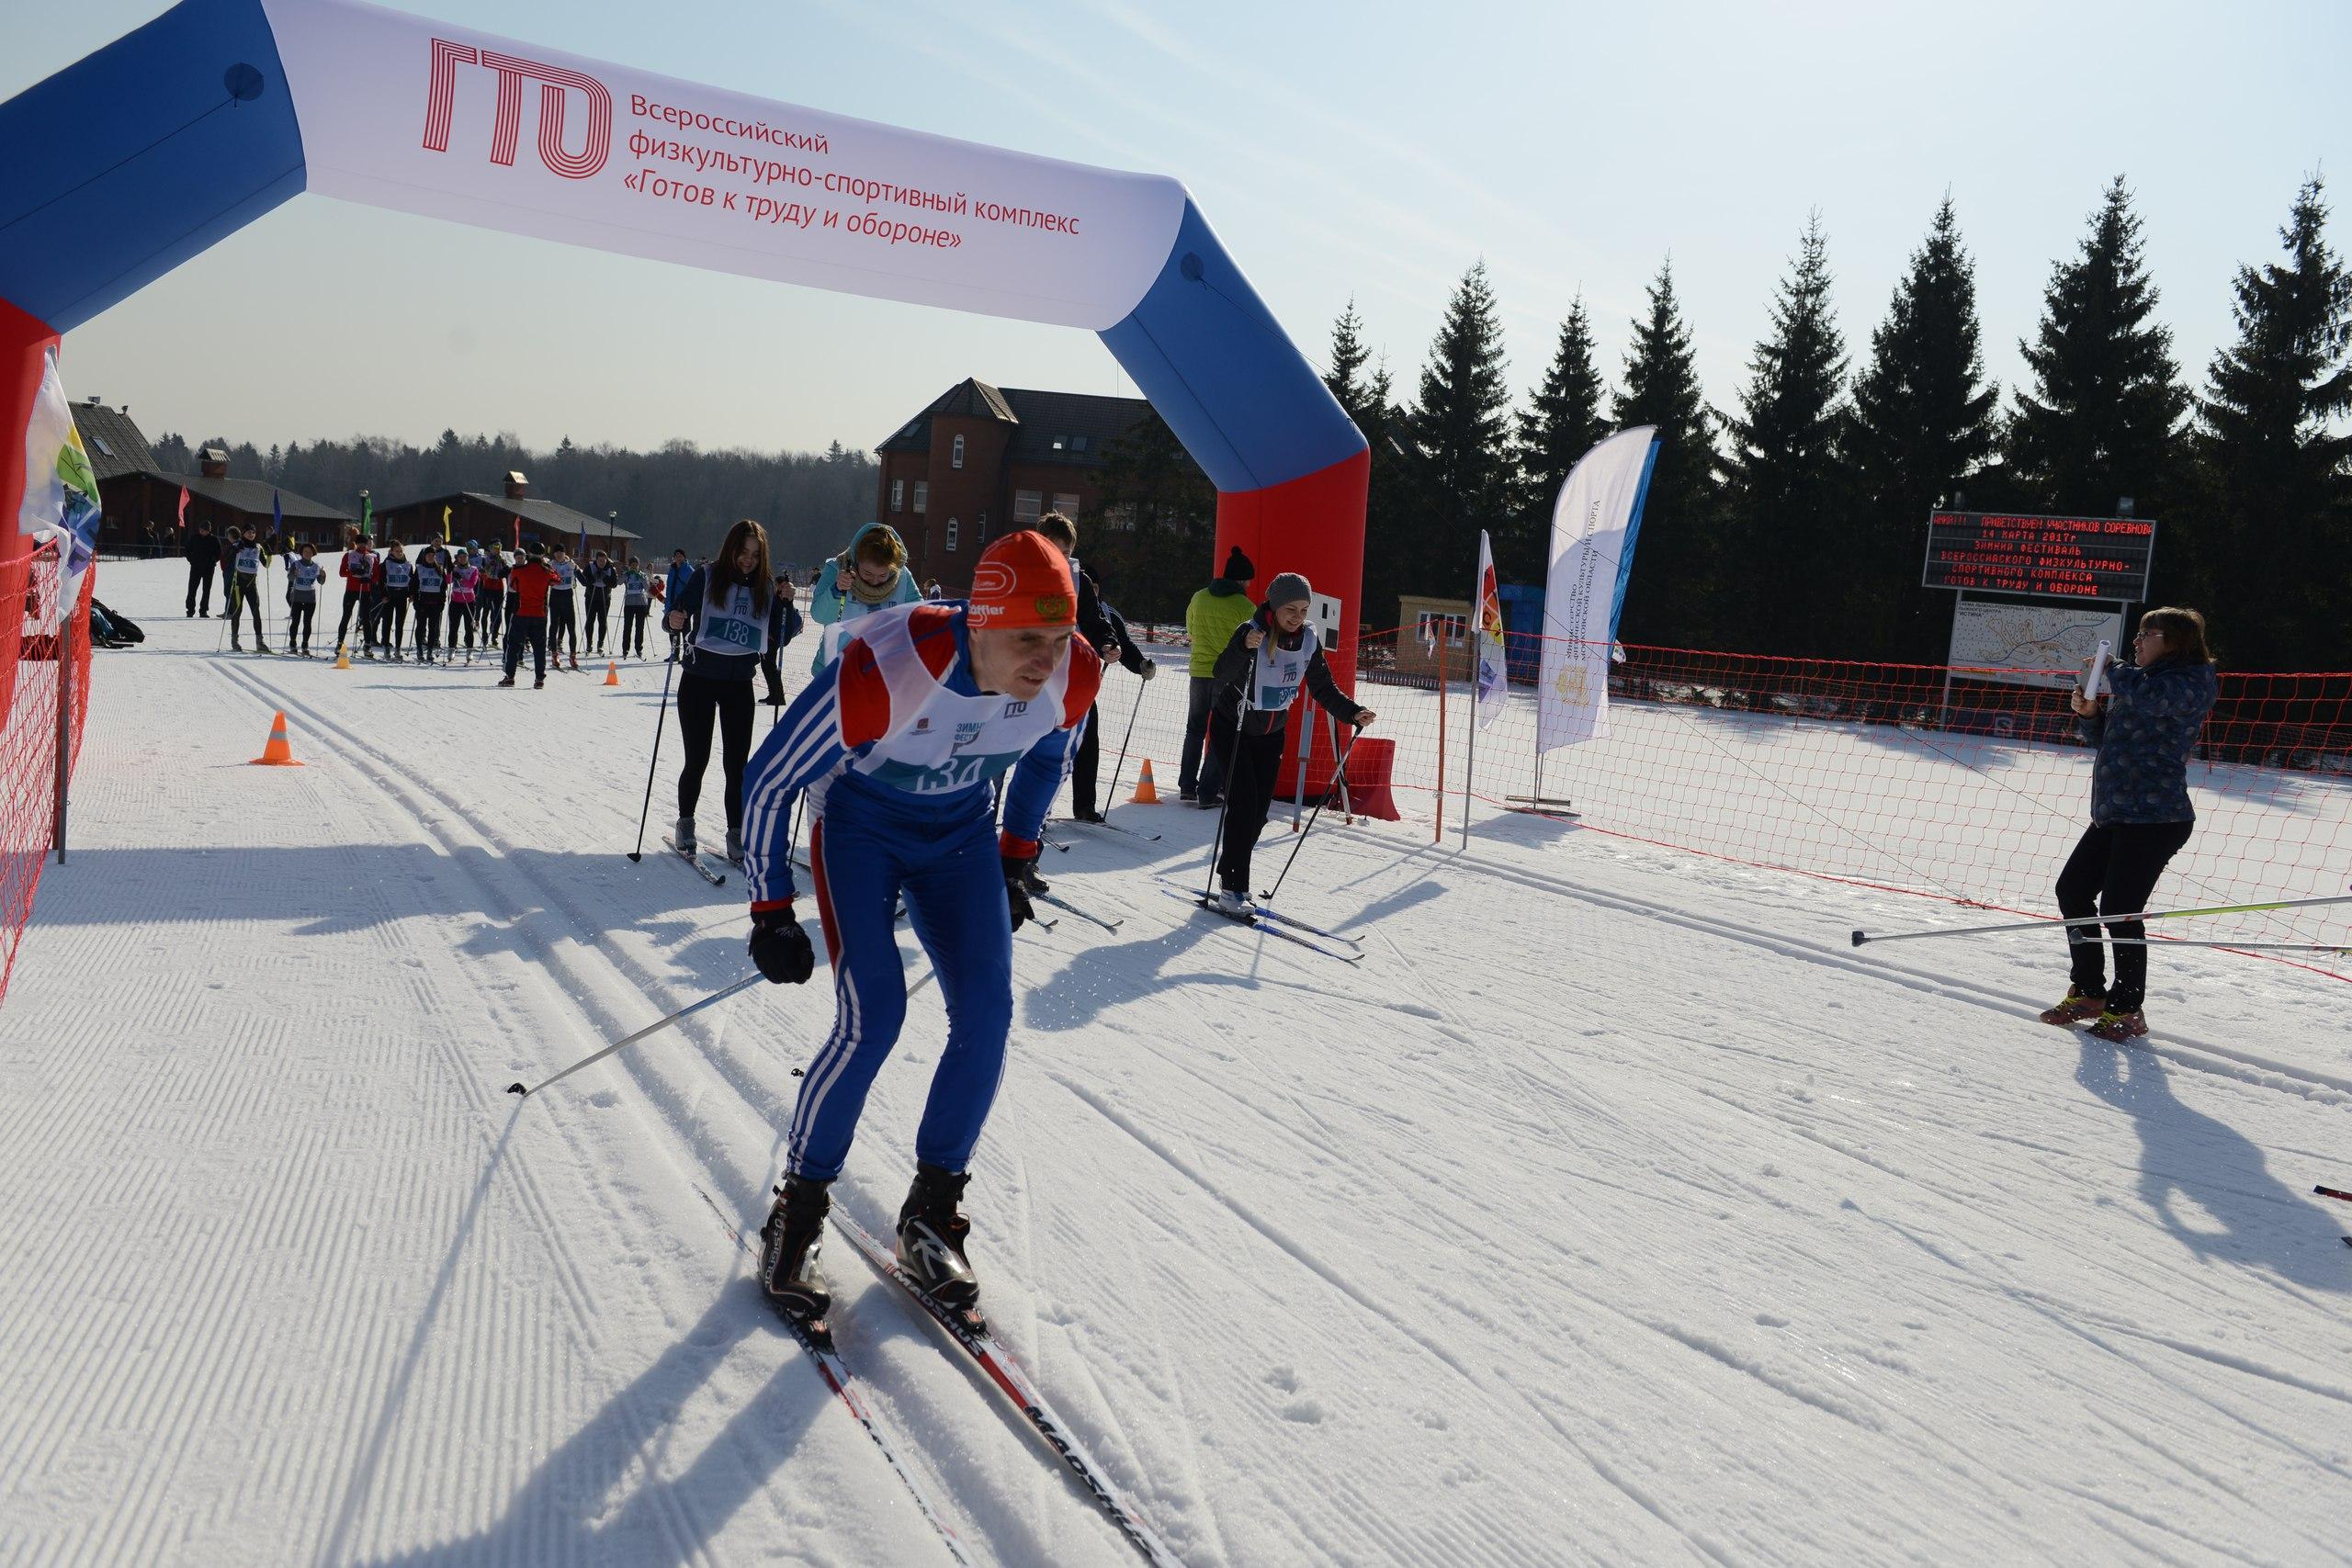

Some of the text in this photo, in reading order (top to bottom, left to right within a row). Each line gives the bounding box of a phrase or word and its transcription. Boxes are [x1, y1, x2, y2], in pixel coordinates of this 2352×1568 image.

[423, 38, 613, 180] ГТО
[630, 94, 829, 153] Всероссийский
[628, 130, 1080, 234] физкультурно-спортивный комплекс
[624, 168, 963, 249] «Готов к труду и обороне»
[1981, 529, 1996, 539] 14
[2001, 530, 2035, 541] МАРТА
[2046, 520, 2100, 533] УЧАСТНИКОВ
[1577, 547, 1590, 595] КУЛЬТУРЫ
[1587, 500, 1601, 537] СПОРТА
[2020, 543, 2083, 556] ФЕСТИВАЛЬ
[1586, 550, 1598, 593] ОБЛАСТИ
[1951, 564, 2095, 582] СПОРТИВНОГО КОМПЛЕКСА
[2039, 557, 2132, 571] ФИЗКУЛЬТУРНО-
[1996, 579, 2029, 591] ТРУДУ
[2049, 582, 2099, 596] ОБОРОНЕ
[723, 619, 750, 646] 138
[1566, 583, 1577, 660] МИНИСТЕРСТВО
[1004, 701, 1028, 716] ГТО
[956, 722, 986, 733] ЗИМН
[892, 1271, 984, 1358] MADSHUS
